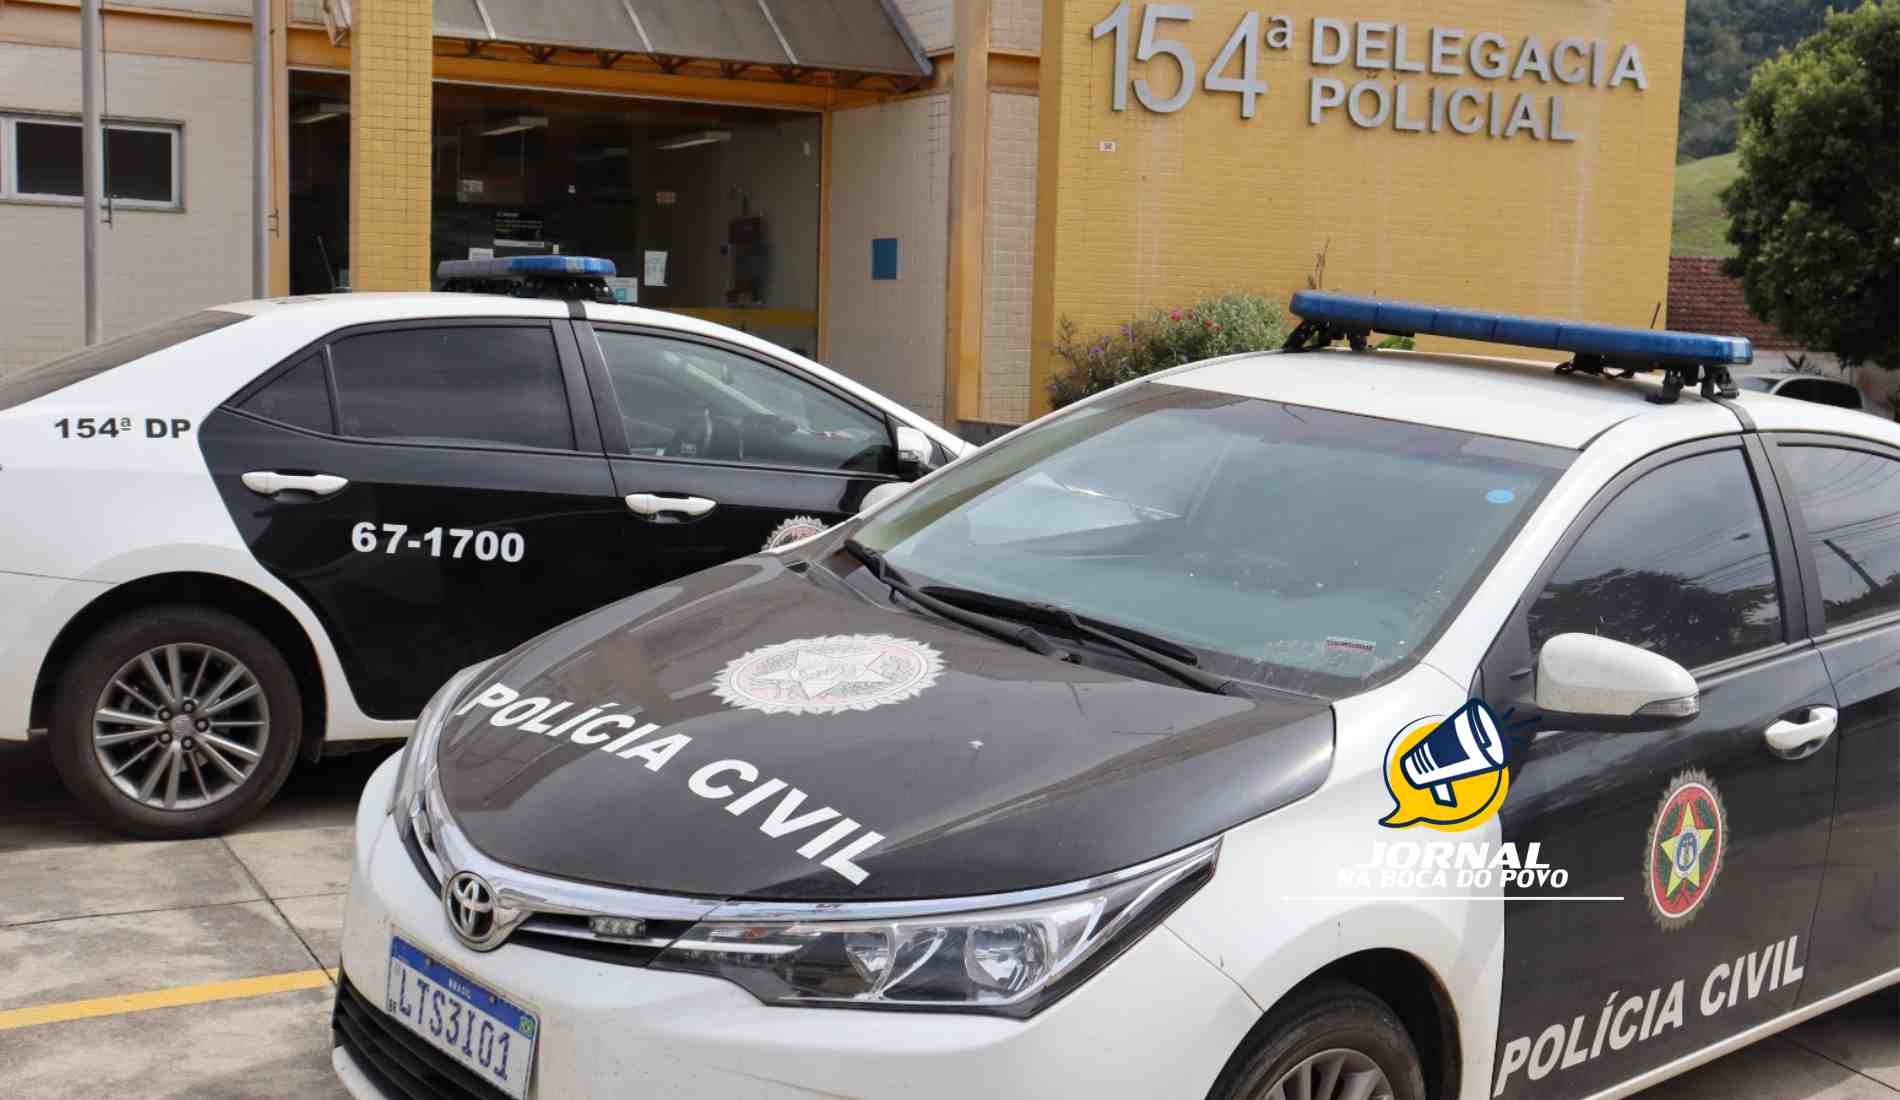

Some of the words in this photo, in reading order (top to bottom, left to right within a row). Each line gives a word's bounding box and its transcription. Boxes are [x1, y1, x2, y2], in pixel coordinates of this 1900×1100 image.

[1310, 16, 1649, 91] DELEGACIA
[1308, 75, 1577, 142] POLICIAL
[145, 418, 191, 439] DP
[351, 521, 525, 563] 67-1700
[456, 683, 693, 772] POLÍCIA
[688, 759, 887, 886] CIVIL
[1492, 979, 1686, 1098] POLÍCIA
[1700, 935, 1804, 1017] CIVIL
